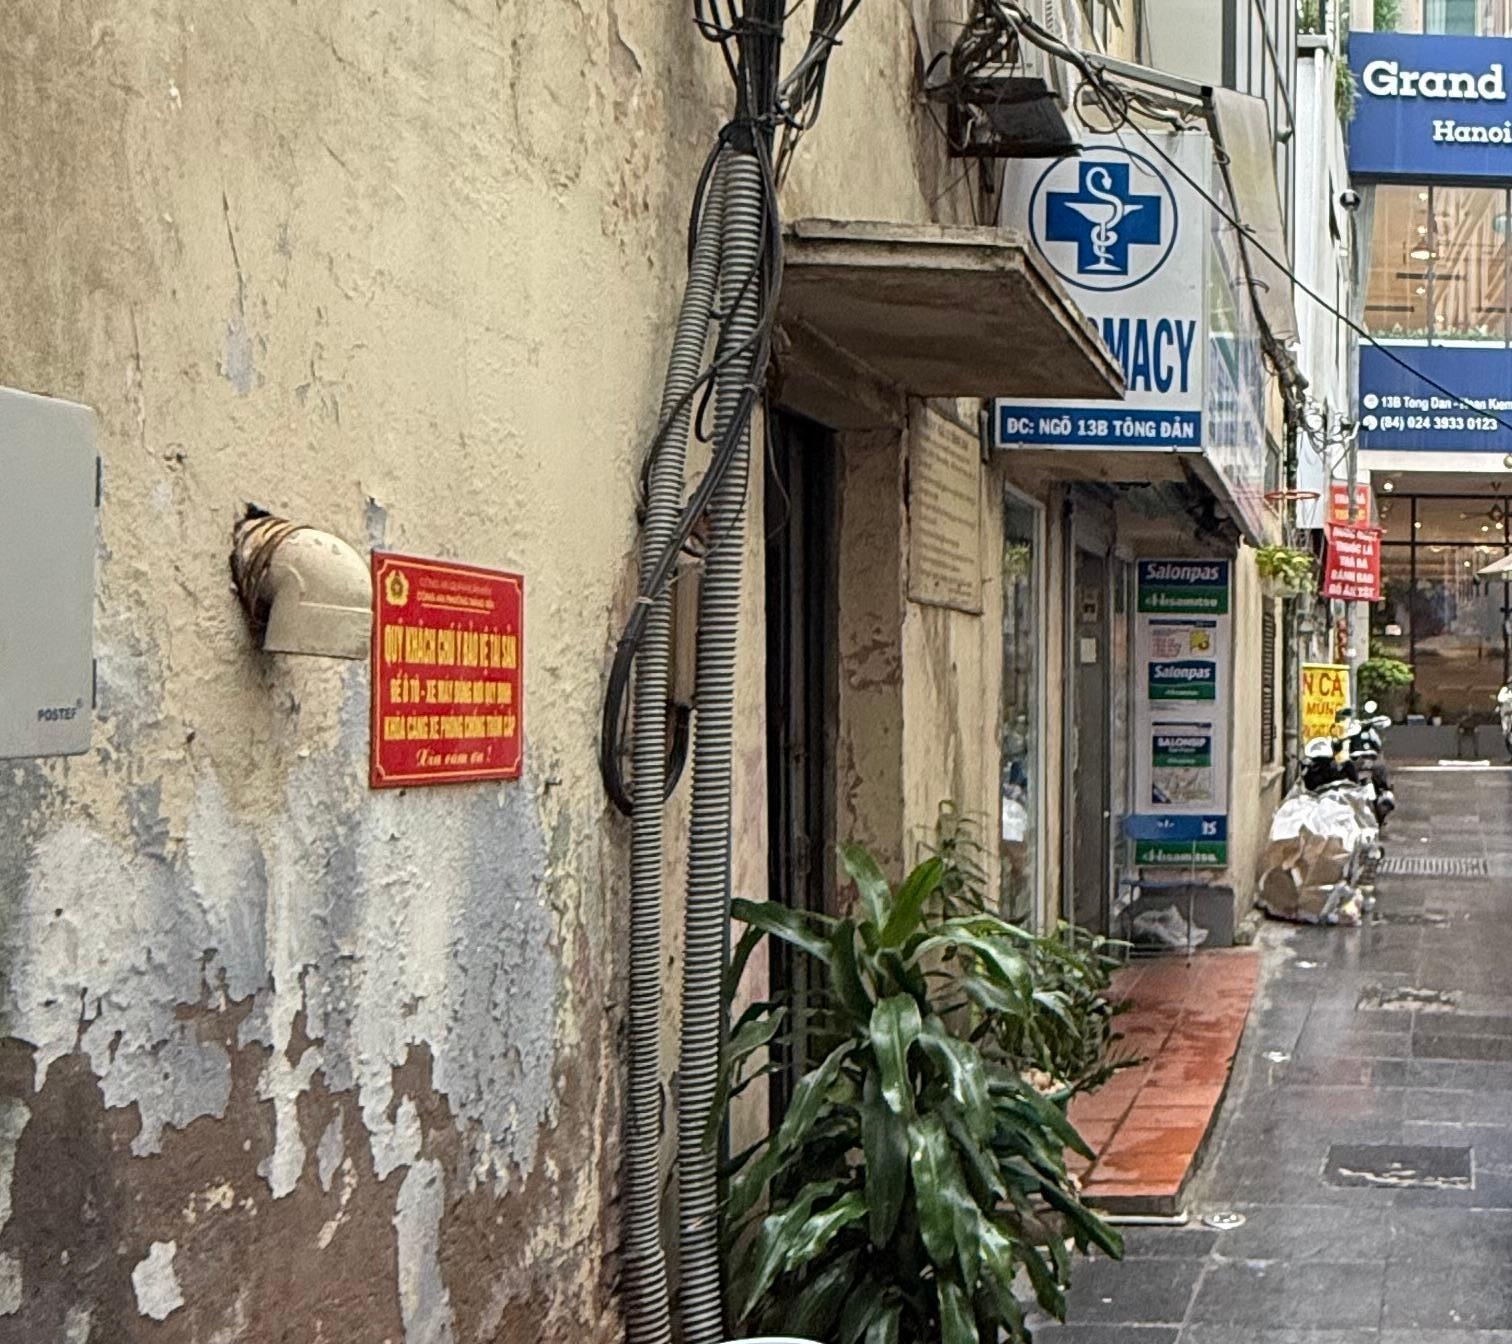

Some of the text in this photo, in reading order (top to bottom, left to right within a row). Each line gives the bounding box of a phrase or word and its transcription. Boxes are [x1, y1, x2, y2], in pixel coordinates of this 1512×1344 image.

[1362, 60, 1507, 102] Grand
[1432, 119, 1512, 144] Hanoi
[1087, 317, 1197, 394] MACY
[1077, 419, 1108, 437] 13B
[1380, 416, 1498, 432] (84) 024 3933 0123
[1145, 562, 1219, 584] Salonpas
[1153, 664, 1211, 681] Salonpas
